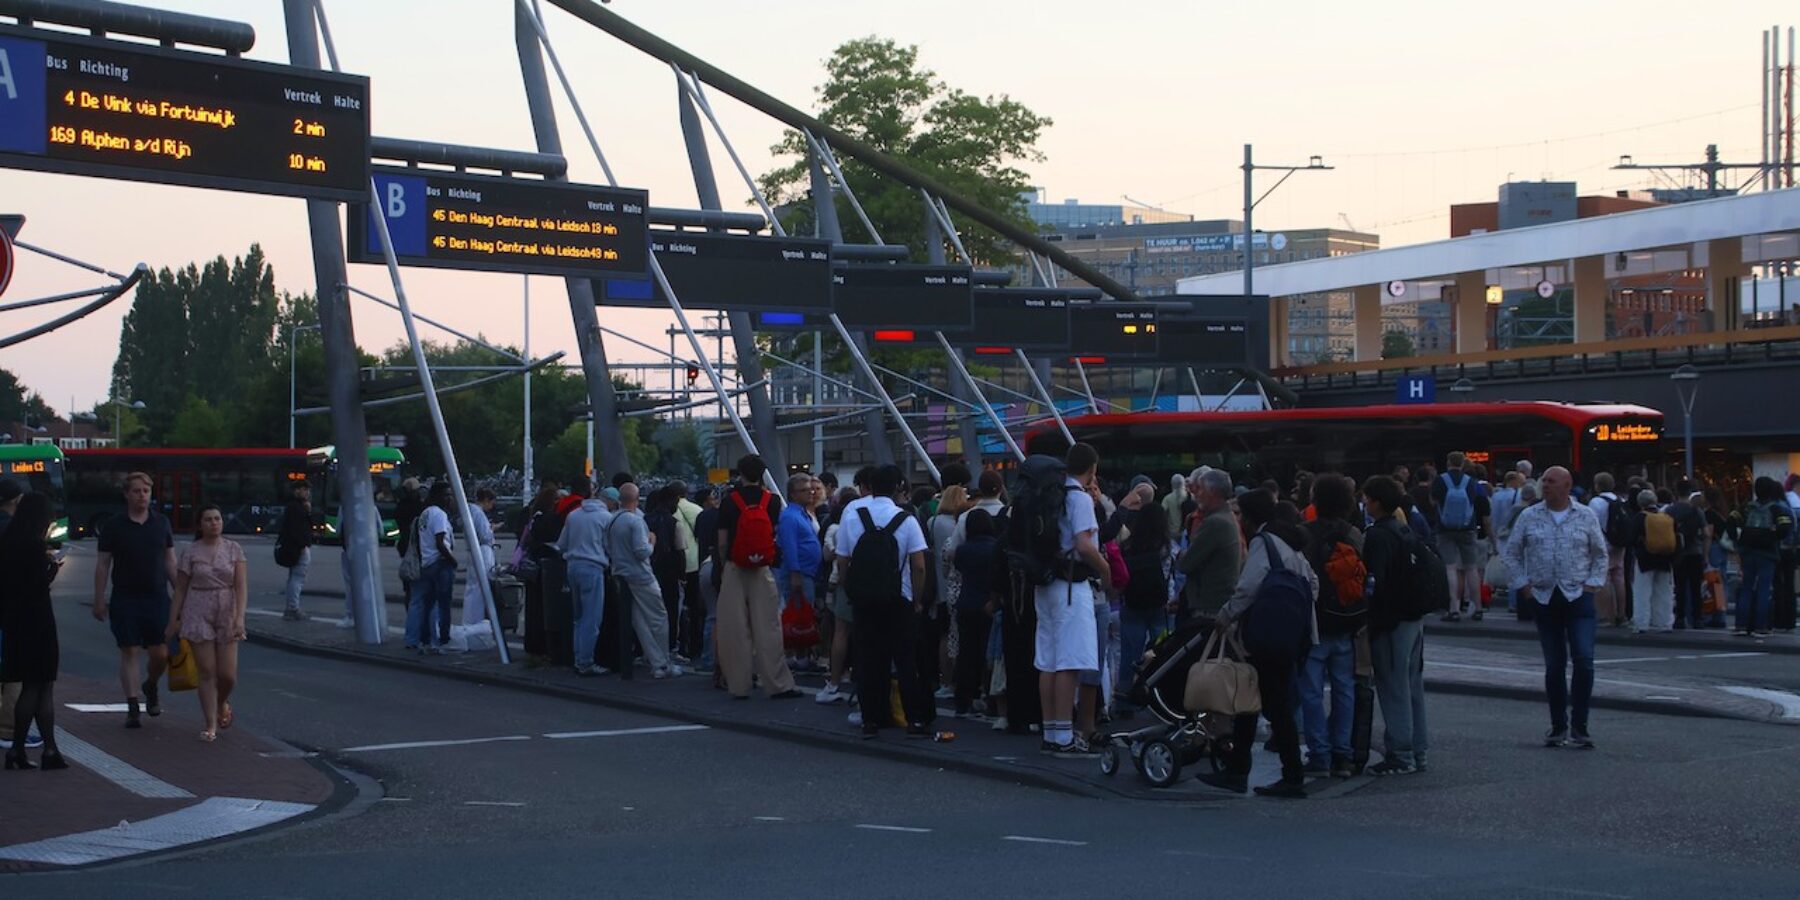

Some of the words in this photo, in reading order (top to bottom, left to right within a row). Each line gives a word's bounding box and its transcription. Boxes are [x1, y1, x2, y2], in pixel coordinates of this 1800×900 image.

[46, 55, 69, 70] Bus
[80, 60, 129, 81] Richting
[284, 88, 322, 104] Vertrek
[334, 95, 360, 109] Halte
[64, 90, 75, 105] 4
[80, 91, 99, 109] De
[103, 94, 132, 113] Vink
[136, 100, 157, 116] via
[160, 102, 236, 129] Fortuinwijk
[293, 119, 304, 134] 2
[306, 121, 326, 137] min
[50, 126, 76, 143] 169
[80, 130, 130, 151] Alphen
[134, 138, 160, 154] a/d
[164, 139, 191, 160] Rijn
[289, 153, 304, 170] 10
[306, 156, 326, 172] min
[387, 182, 406, 218] B
[426, 186, 441, 196] Bus
[448, 188, 481, 202] Richting
[587, 201, 615, 212] Vertrek
[622, 203, 642, 214] Halte
[432, 209, 446, 221] 45
[449, 210, 468, 223] Den
[469, 212, 495, 228] Haag
[496, 214, 539, 229] Centraal
[541, 218, 555, 230] via
[432, 235, 446, 248] 45
[449, 237, 468, 250] Den
[469, 239, 495, 254] Haag
[496, 240, 539, 255] Centraal
[541, 244, 555, 256] via
[670, 243, 697, 255] Richting
[782, 250, 804, 260] Vertrek
[811, 251, 827, 260] Halte
[1410, 380, 1423, 398] H
[34, 460, 45, 472] CS
